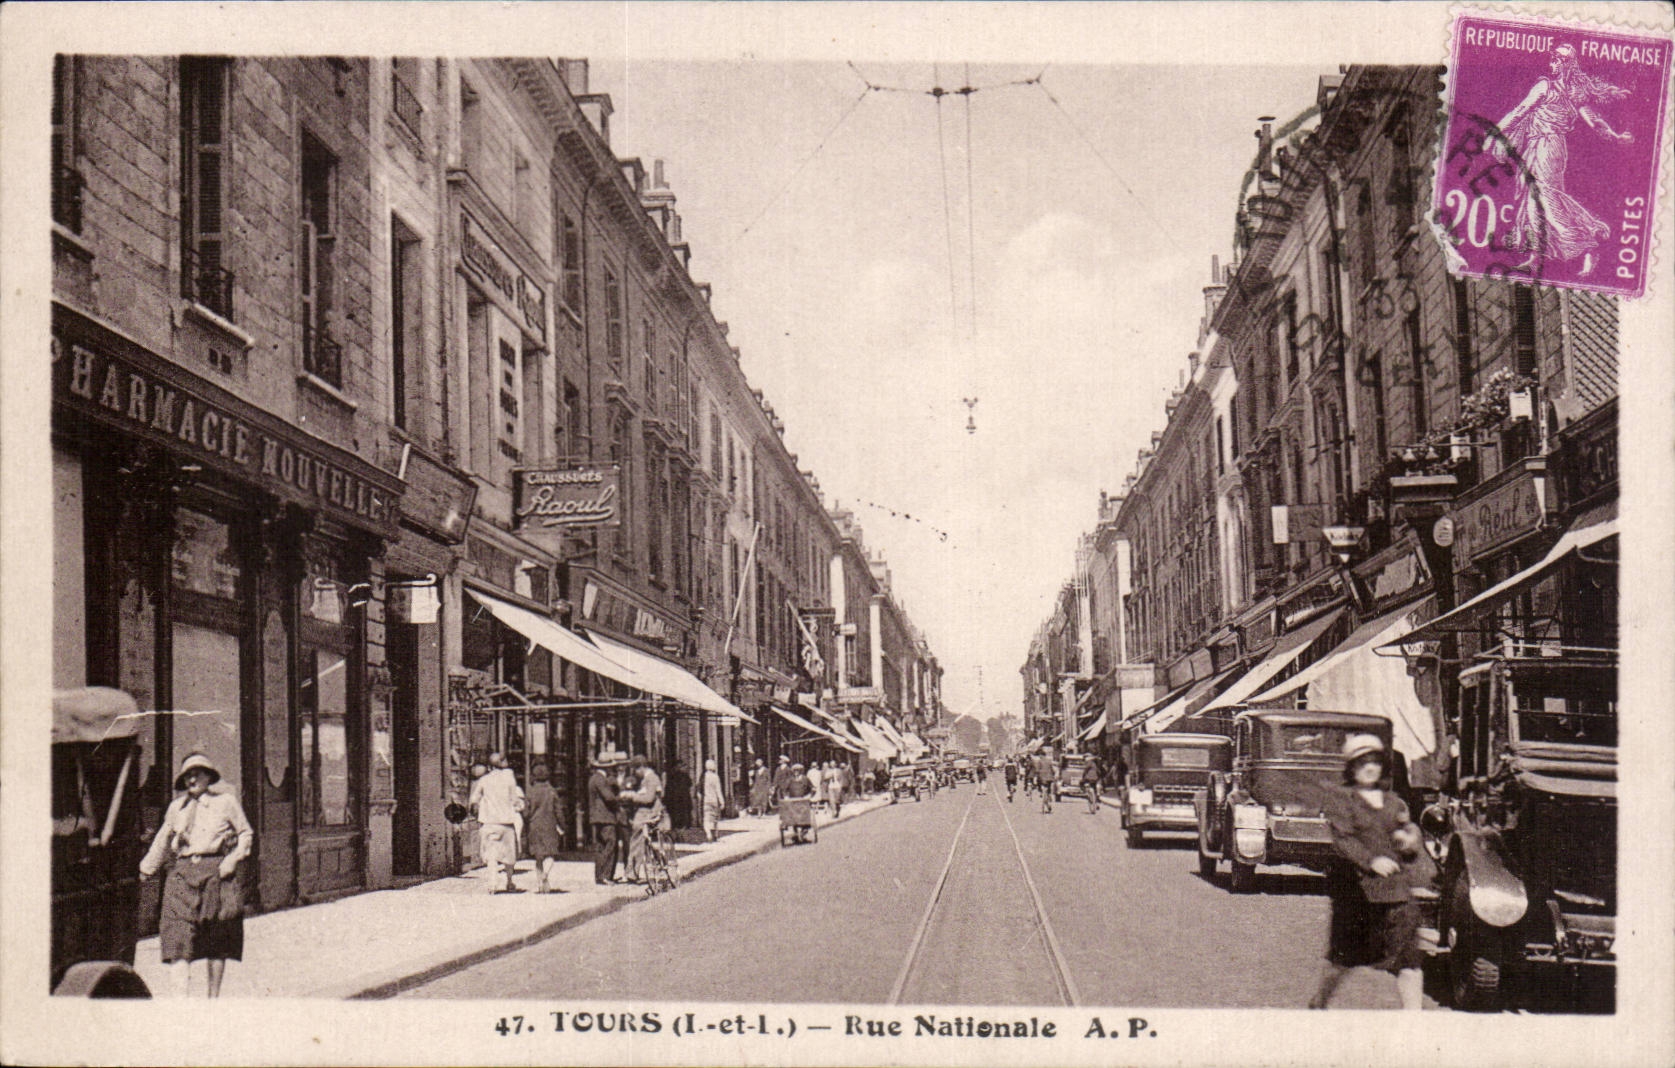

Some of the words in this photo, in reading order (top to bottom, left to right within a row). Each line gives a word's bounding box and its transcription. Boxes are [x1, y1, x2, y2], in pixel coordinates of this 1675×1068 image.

[1581, 40, 1662, 66] FRANÇAISE
[1616, 196, 1645, 279] POSTES
[262, 435, 382, 520] NOUVELLE
[516, 484, 616, 526] Raoul
